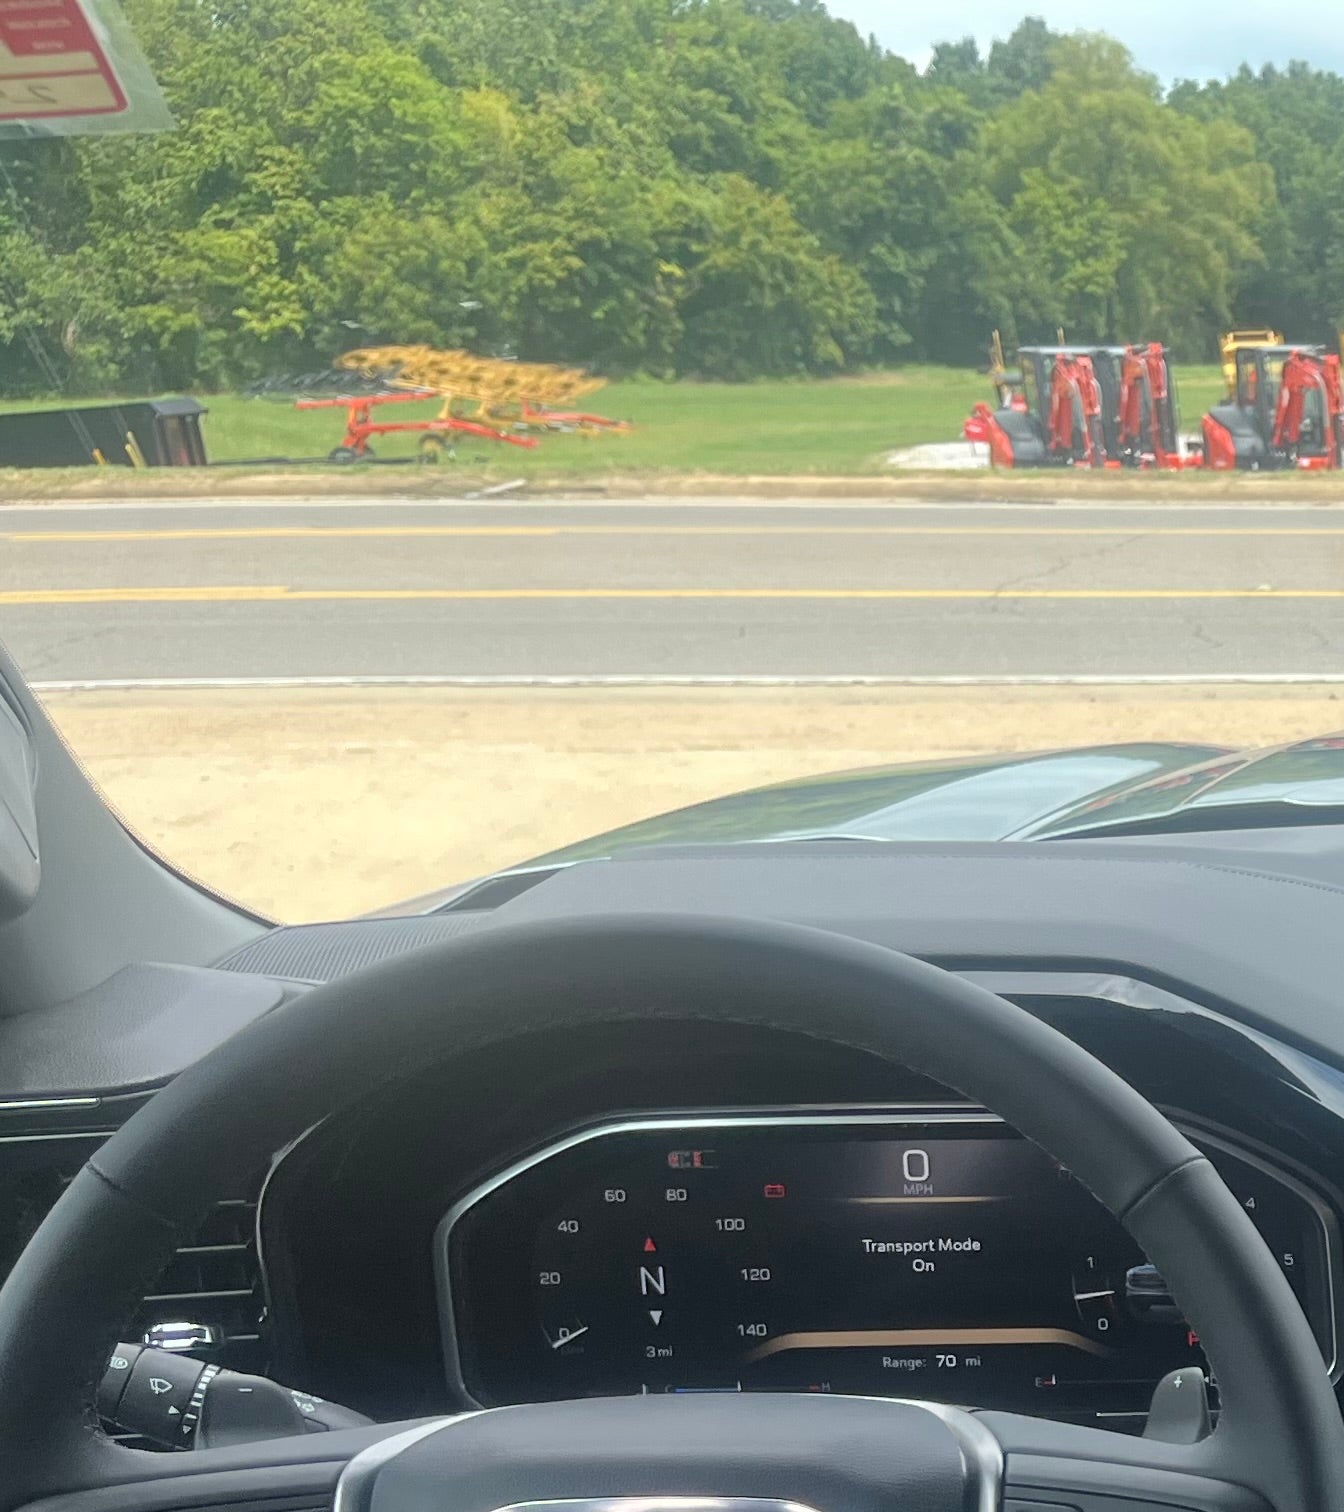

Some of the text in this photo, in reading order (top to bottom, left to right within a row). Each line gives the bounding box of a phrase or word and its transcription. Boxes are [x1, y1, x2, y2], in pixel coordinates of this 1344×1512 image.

[902, 1149, 930, 1182] 0
[666, 1189, 687, 1201] 80
[903, 1183, 933, 1196] MPH
[605, 1190, 626, 1202] 60
[558, 1221, 579, 1233] 40
[715, 1219, 745, 1231] 100
[862, 1238, 981, 1255] Transport Mode
[1087, 1257, 1095, 1268] 1
[1284, 1254, 1294, 1265] 5
[913, 1259, 935, 1273] On
[540, 1273, 560, 1285] 20
[640, 1266, 665, 1295] N
[741, 1269, 770, 1281] 120
[1097, 1317, 1108, 1330] 0
[737, 1324, 767, 1336] 140
[646, 1346, 673, 1358] 3 mi
[882, 1354, 982, 1369] Range: 70 mi
